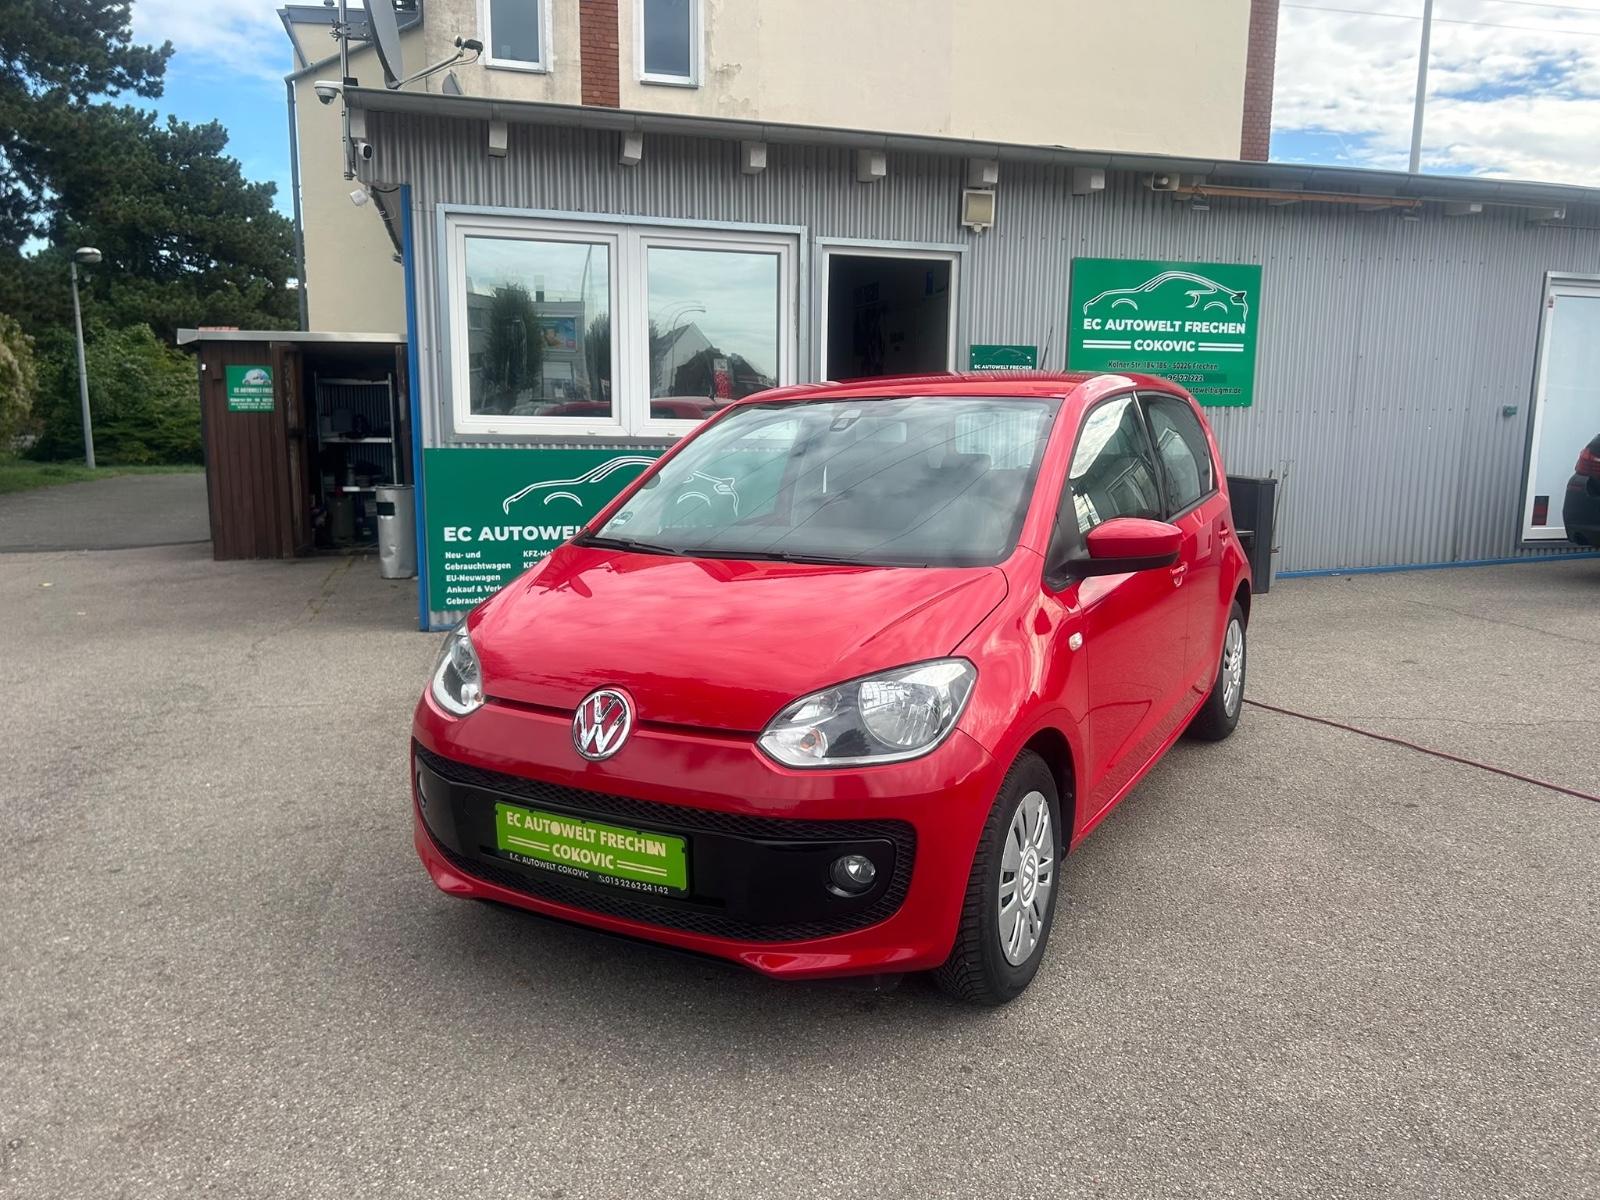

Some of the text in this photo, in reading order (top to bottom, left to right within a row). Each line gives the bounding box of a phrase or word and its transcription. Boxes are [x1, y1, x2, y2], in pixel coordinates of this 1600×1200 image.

[1083, 318, 1246, 335] EC AUTOWELT FRECHEN
[1134, 339, 1196, 352] COKOVIC
[1193, 362, 1218, 371] Frechen
[443, 526, 472, 542] EC
[445, 550, 481, 559] Neu- und
[445, 563, 511, 571] Gebrauchtwagen
[446, 574, 501, 582] EU-Neuwagen
[446, 585, 475, 593] Ankauf
[506, 811, 521, 828] EC
[524, 815, 597, 843] AUTOWELT
[552, 843, 614, 870] COKOVIC
[522, 856, 556, 871] AUTOWELT
[557, 865, 589, 879] COKOVIC
